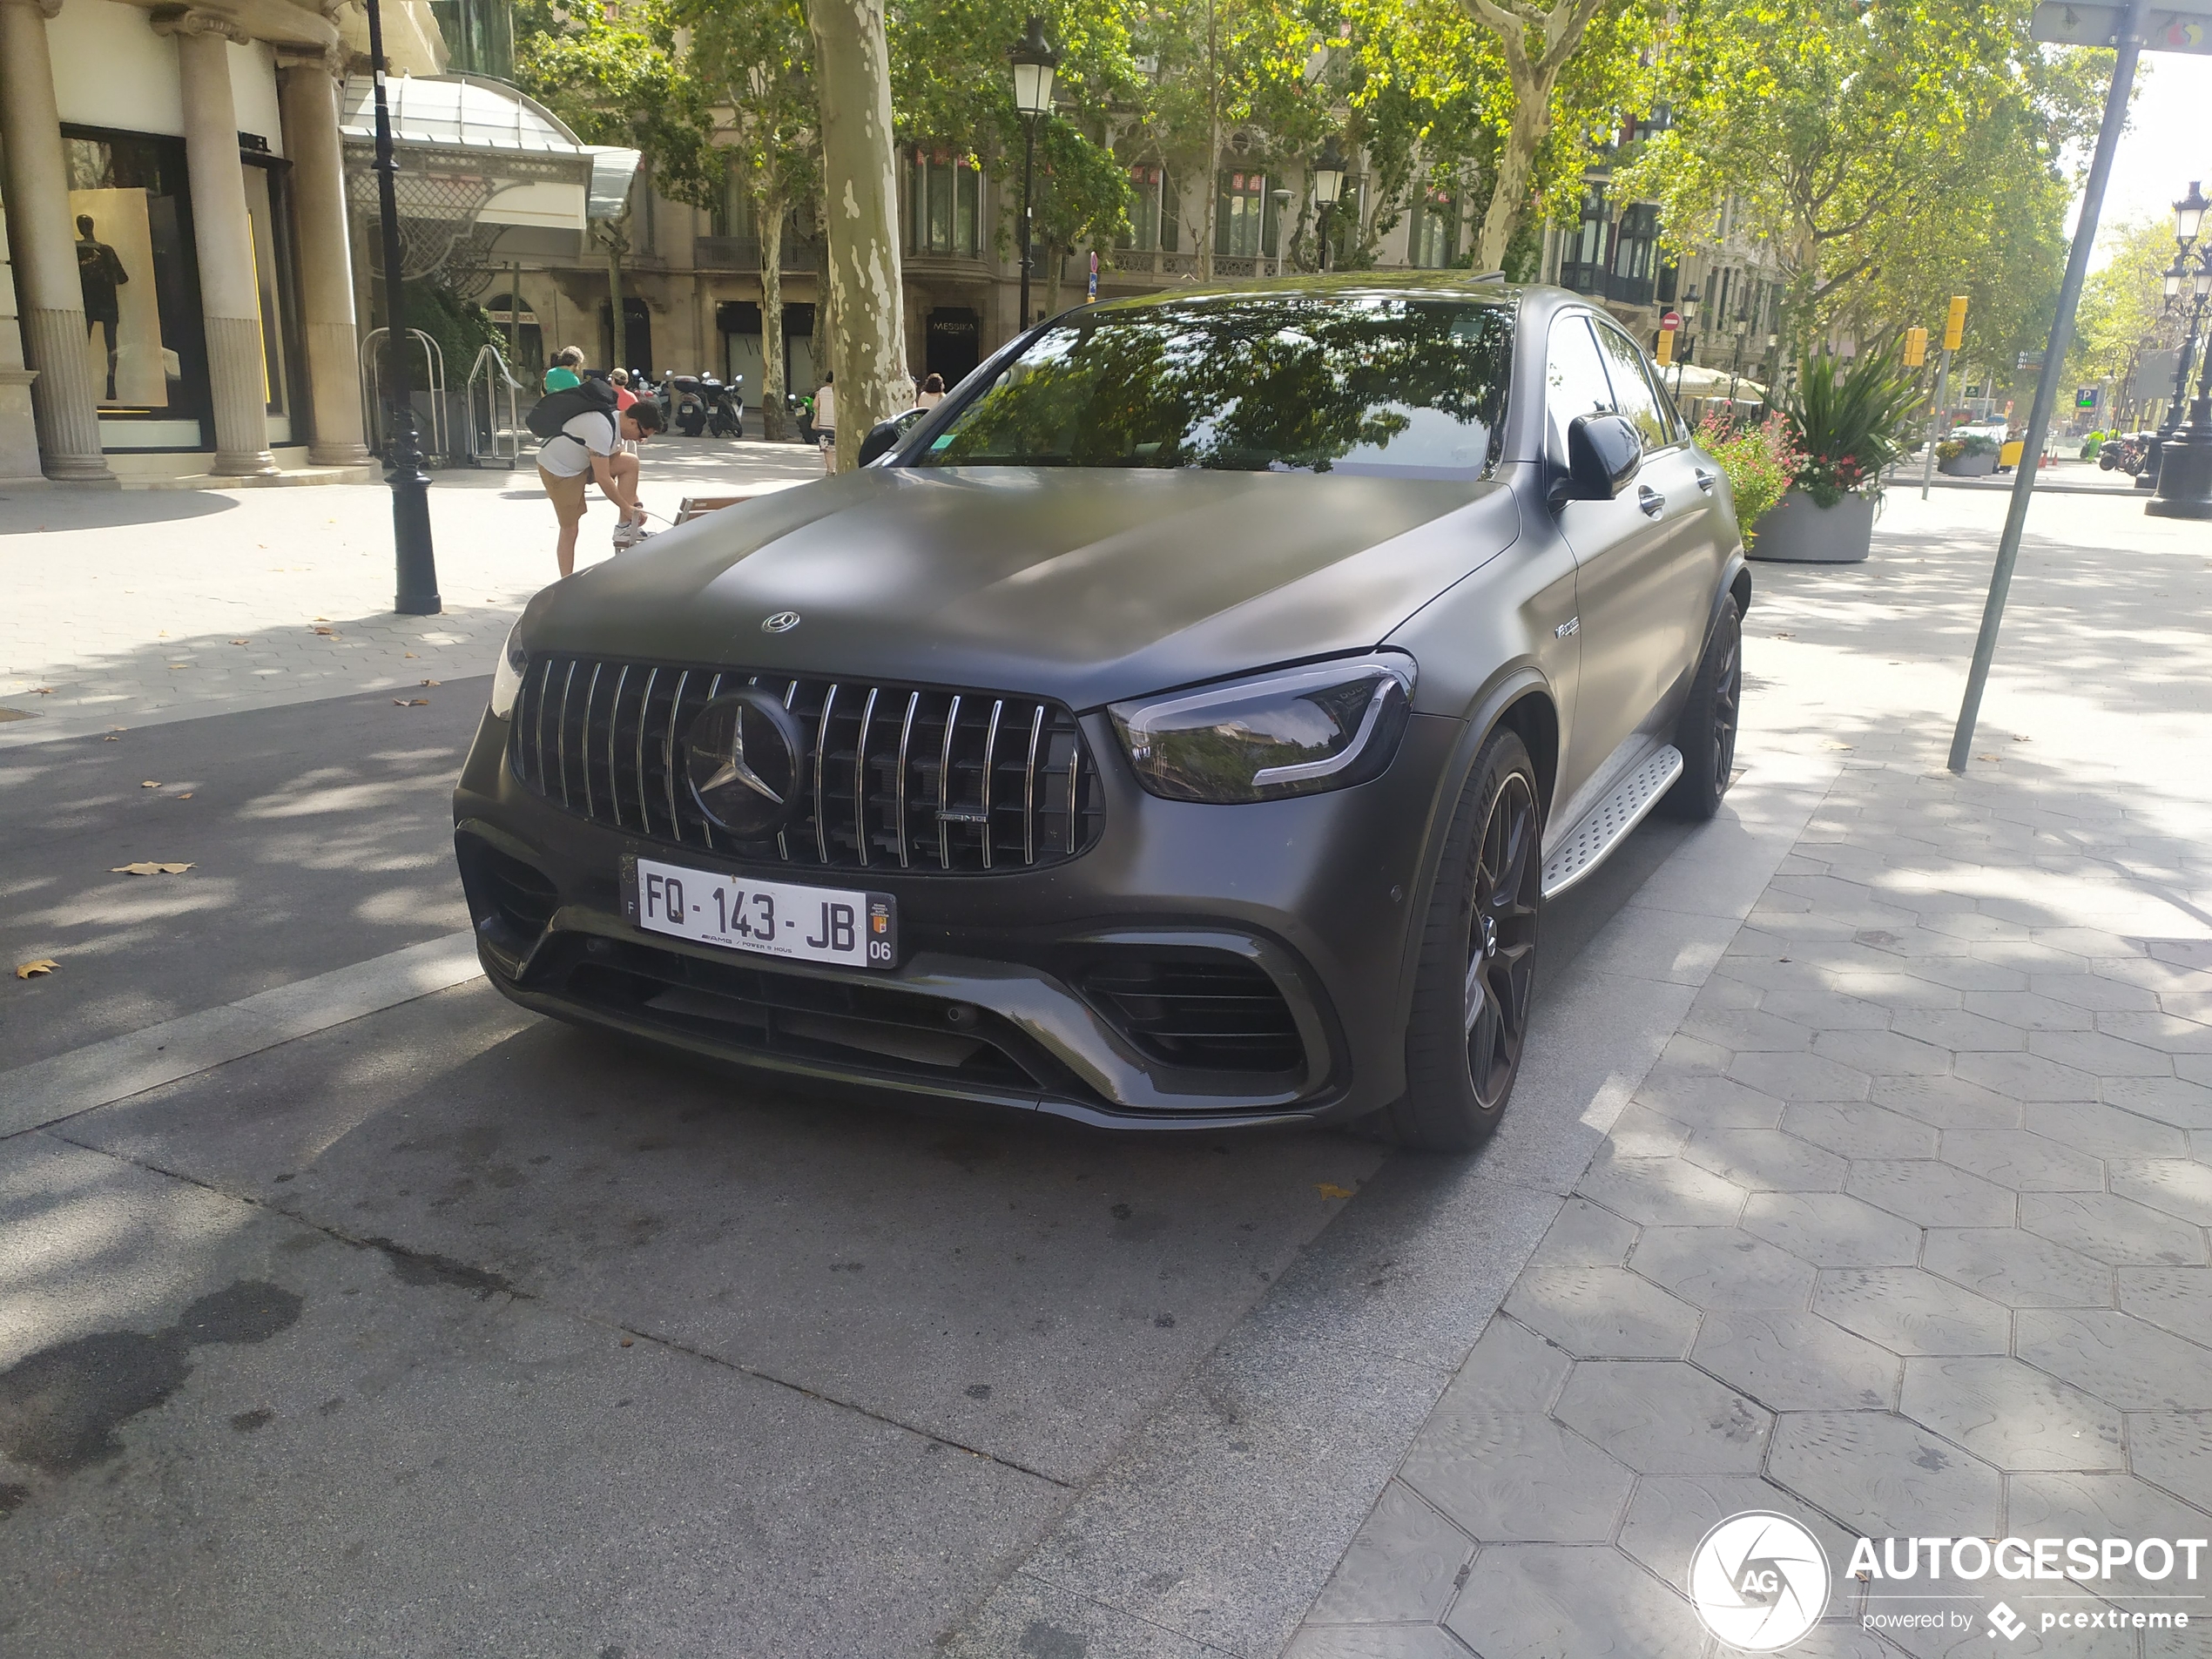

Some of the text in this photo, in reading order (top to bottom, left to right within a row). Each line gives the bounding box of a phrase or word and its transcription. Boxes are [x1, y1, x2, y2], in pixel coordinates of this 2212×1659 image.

[933, 321, 975, 331] MESSIKA
[2082, 390, 2091, 401] P
[627, 901, 634, 914] F
[742, 941, 765, 949] POWER
[869, 940, 892, 961] 06
